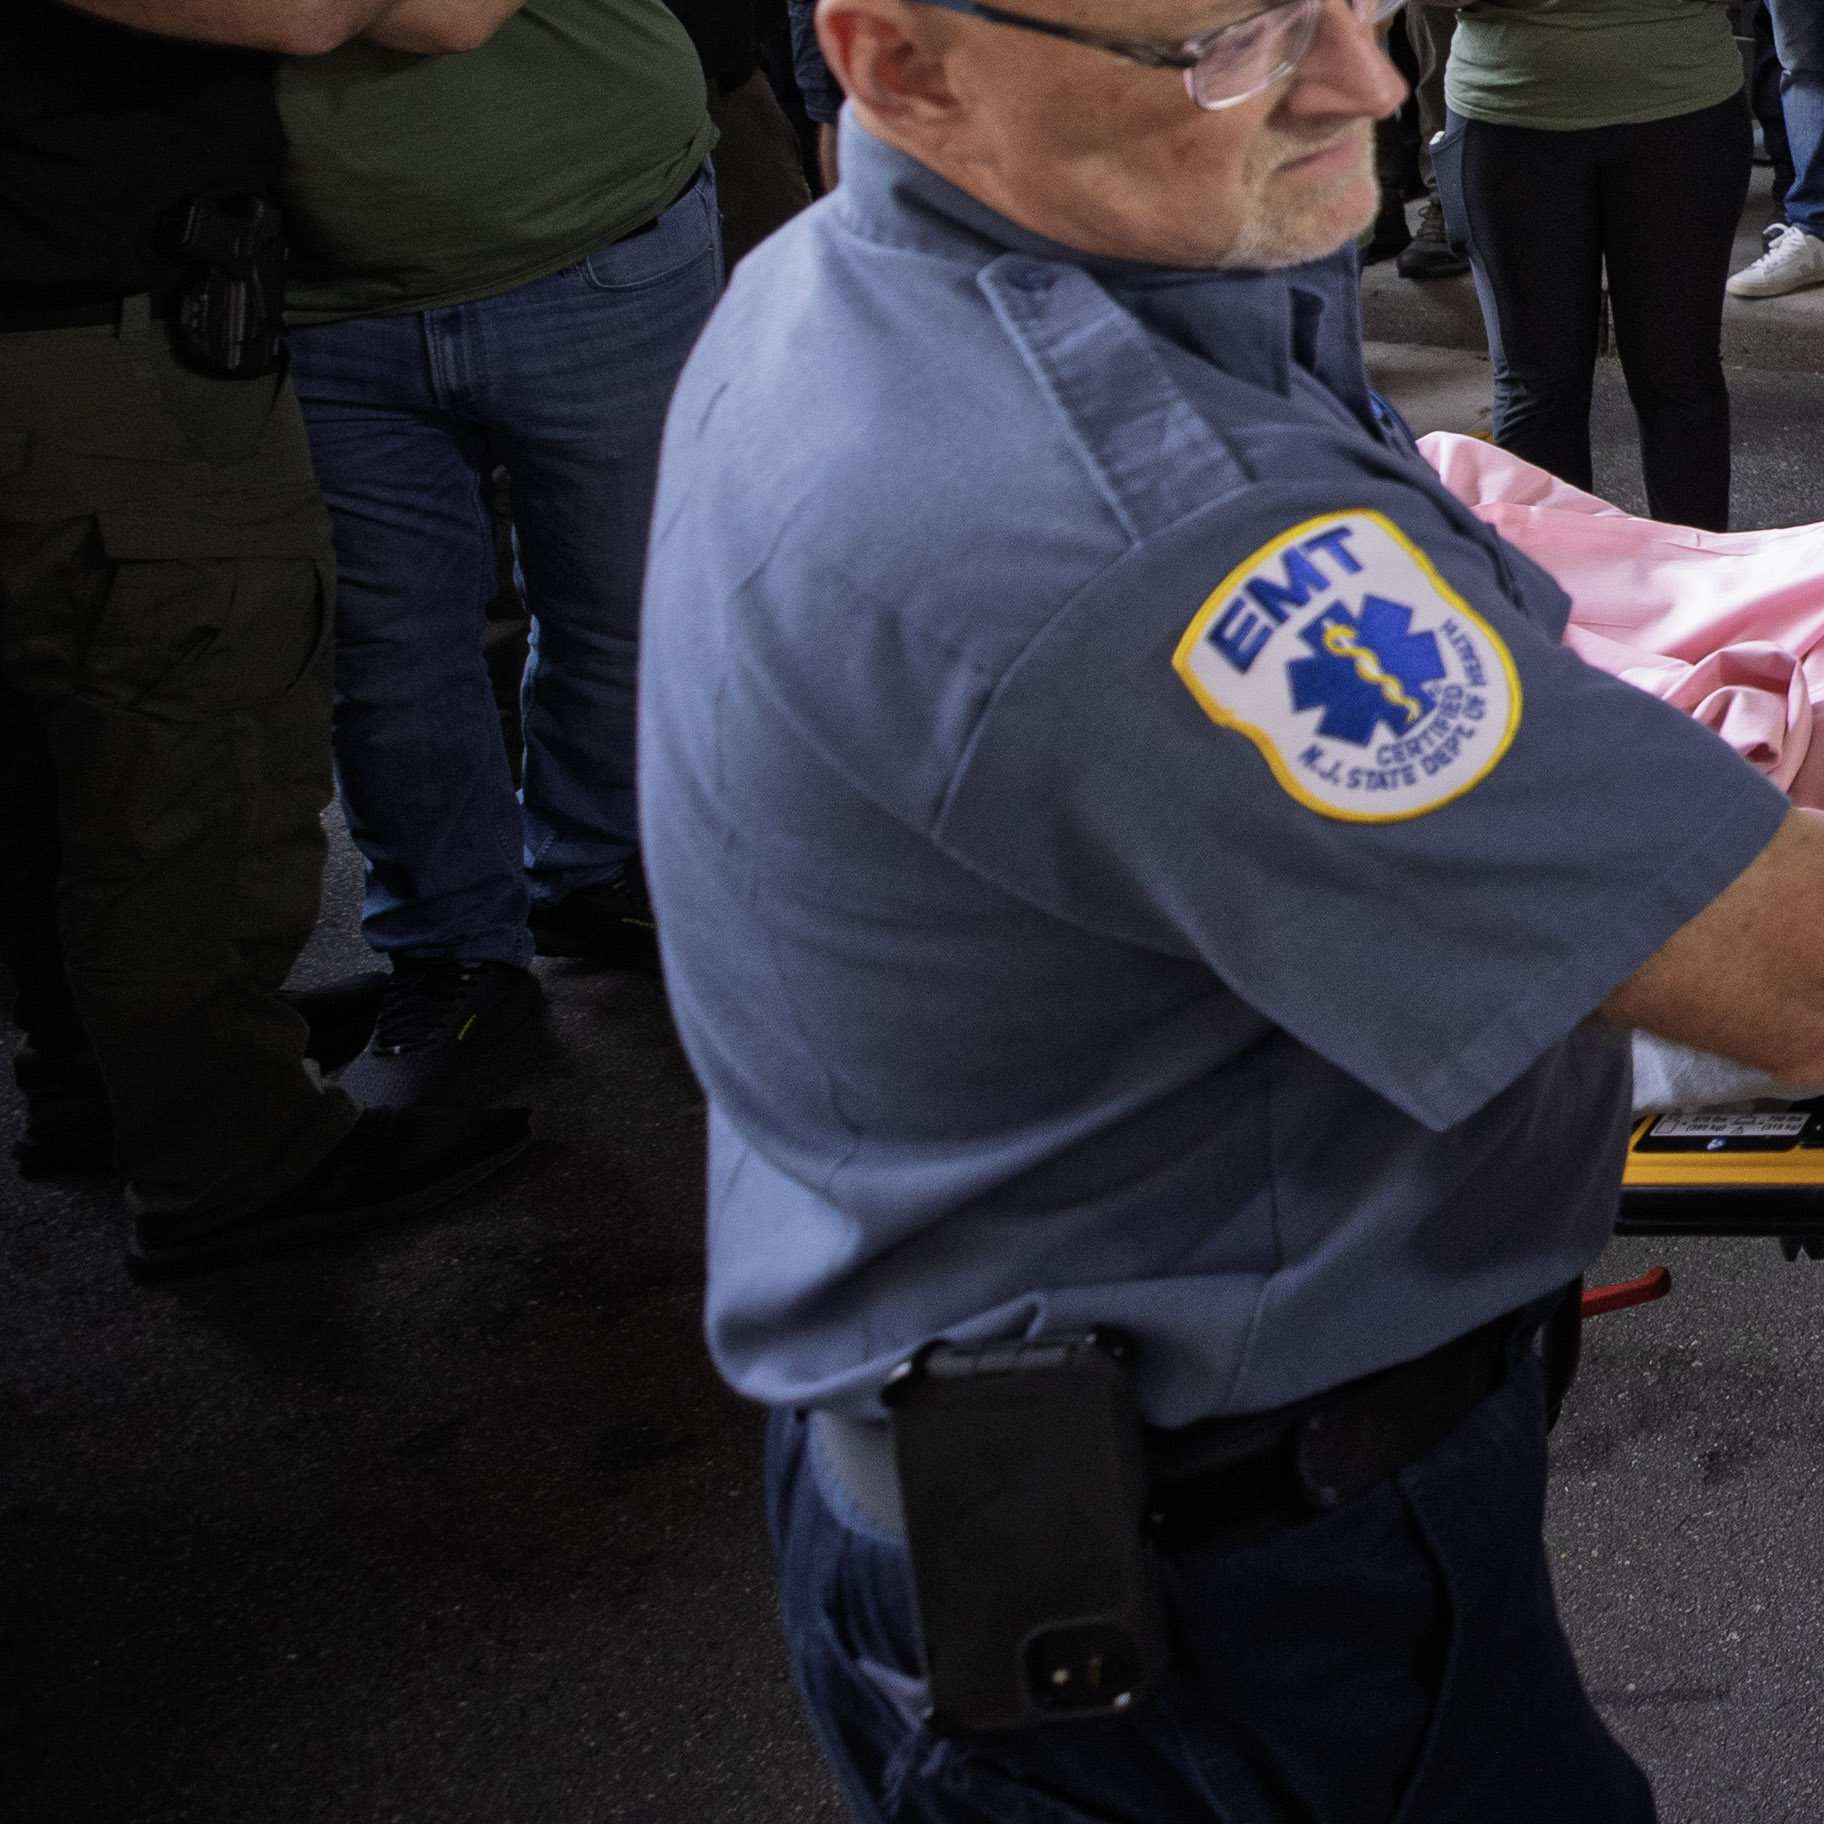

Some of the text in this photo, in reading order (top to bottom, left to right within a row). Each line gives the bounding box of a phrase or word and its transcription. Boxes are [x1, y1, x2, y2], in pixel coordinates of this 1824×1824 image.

[1205, 526, 1364, 675] EMT
[1441, 617, 1487, 687] HEALTH
[1375, 684, 1464, 767] CERTIFIED
[1462, 693, 1487, 723] OF
[1345, 764, 1417, 792] STATE
